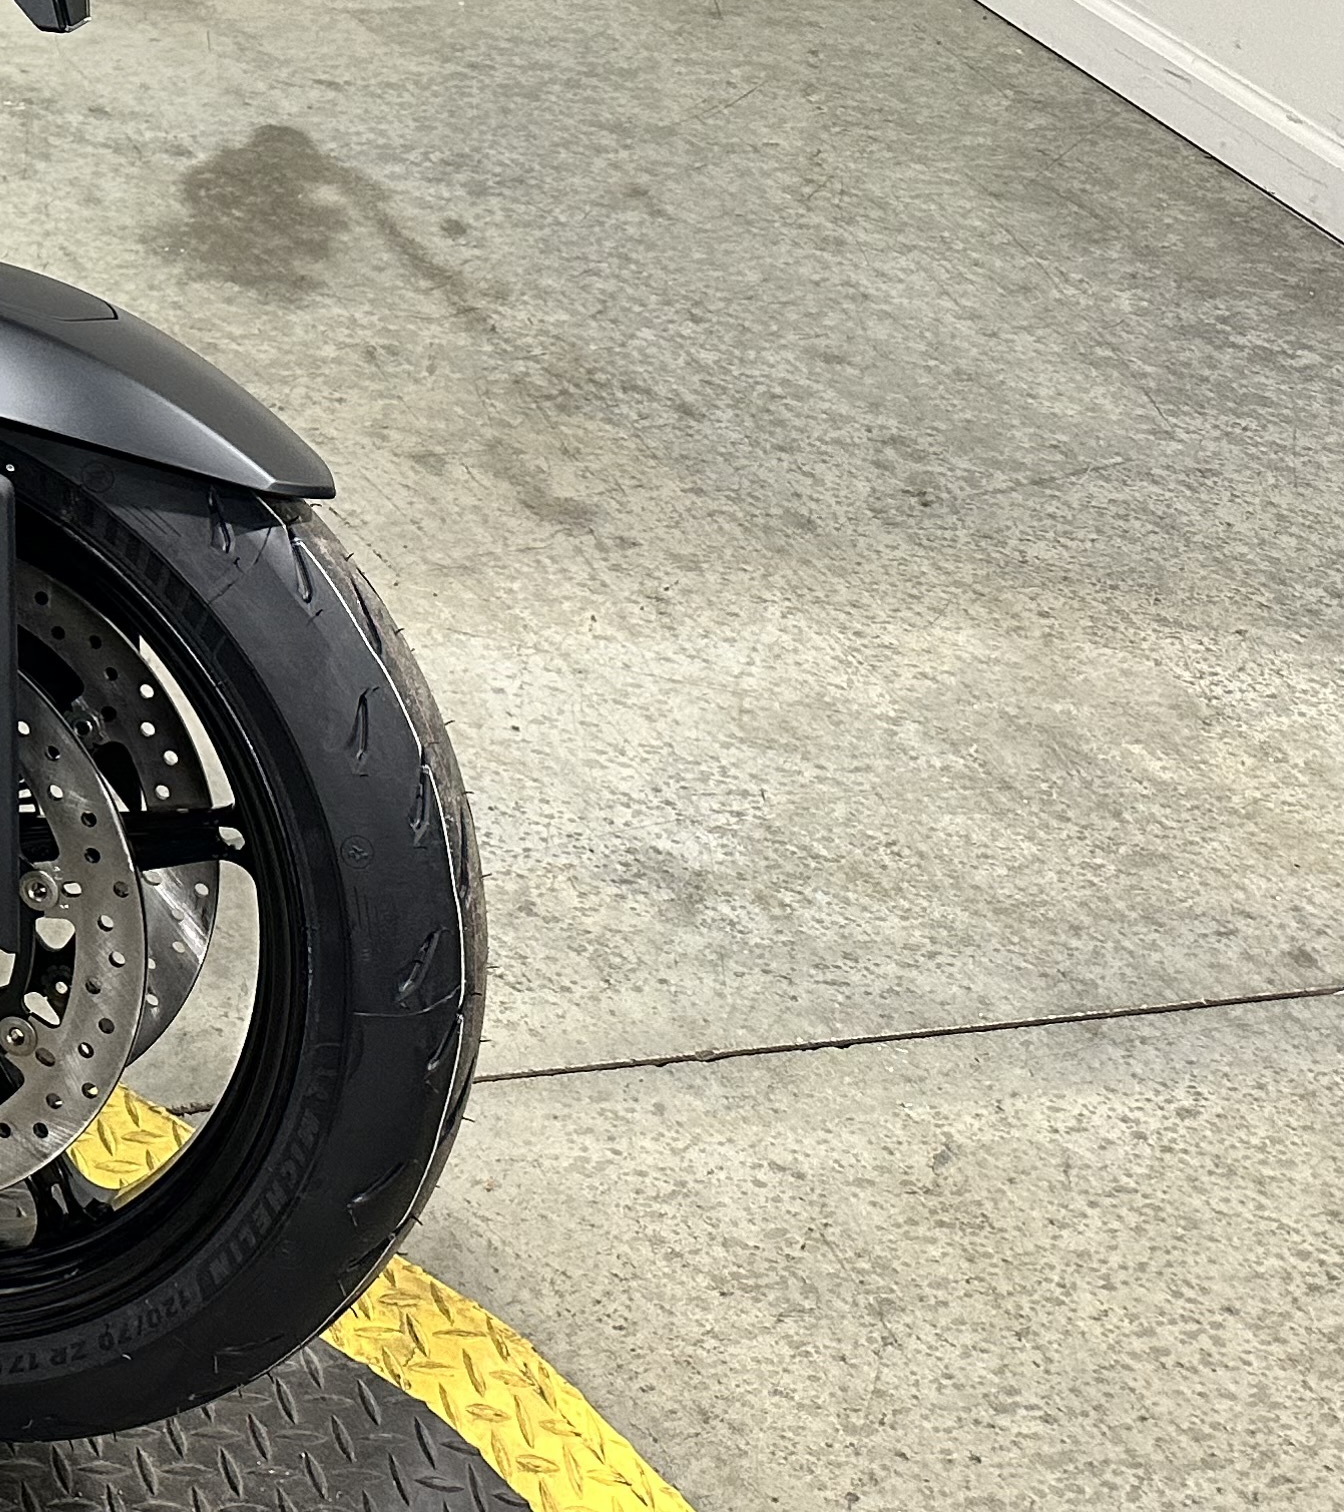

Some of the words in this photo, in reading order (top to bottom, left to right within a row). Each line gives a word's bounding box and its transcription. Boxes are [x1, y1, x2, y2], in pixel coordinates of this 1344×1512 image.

[205, 1114, 321, 1287] MICHELIN
[97, 1287, 189, 1351] 120/70
[9, 1349, 40, 1374] 17
[47, 1342, 87, 1367] ZR
